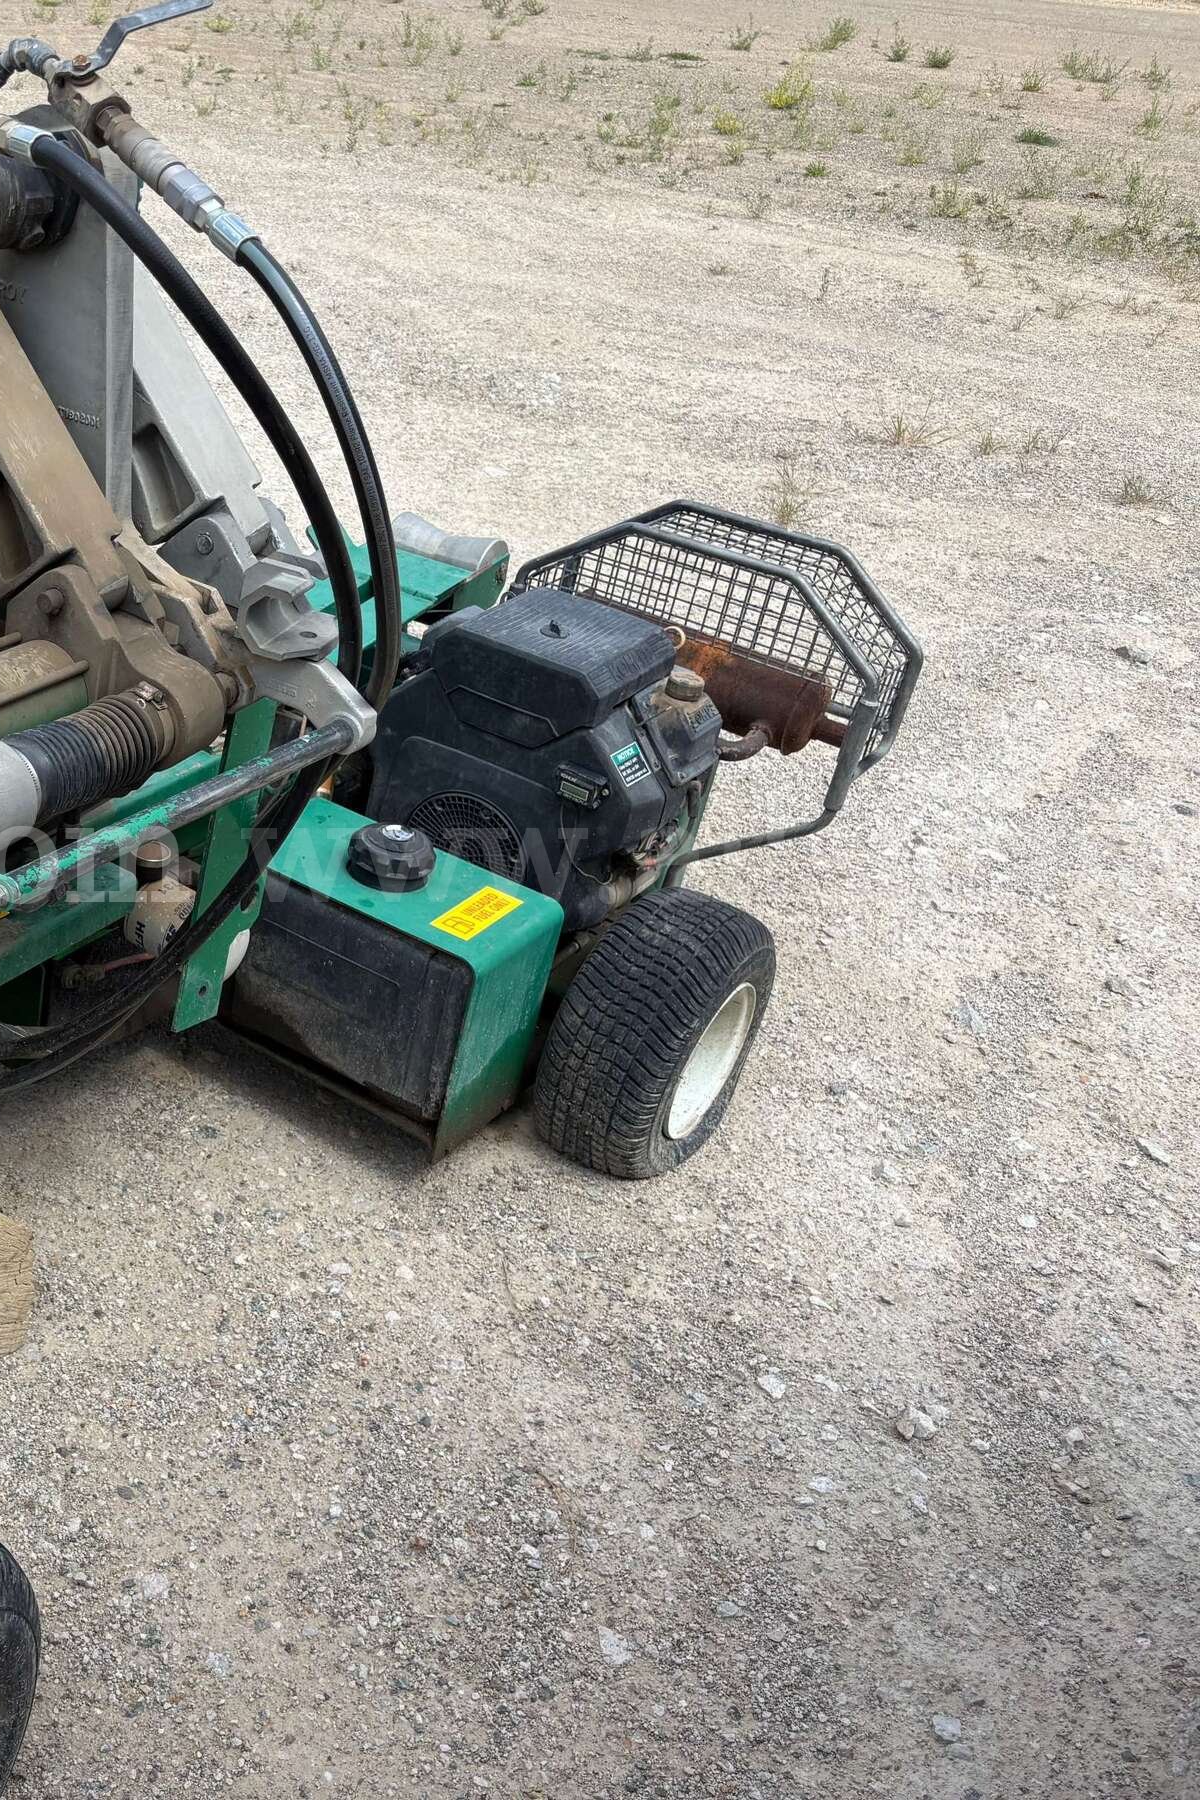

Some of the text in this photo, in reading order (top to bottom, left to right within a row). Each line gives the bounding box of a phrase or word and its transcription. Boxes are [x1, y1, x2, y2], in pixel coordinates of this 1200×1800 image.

[461, 893, 499, 916] UNLEADED
[473, 897, 511, 922] FUEL ONLY
